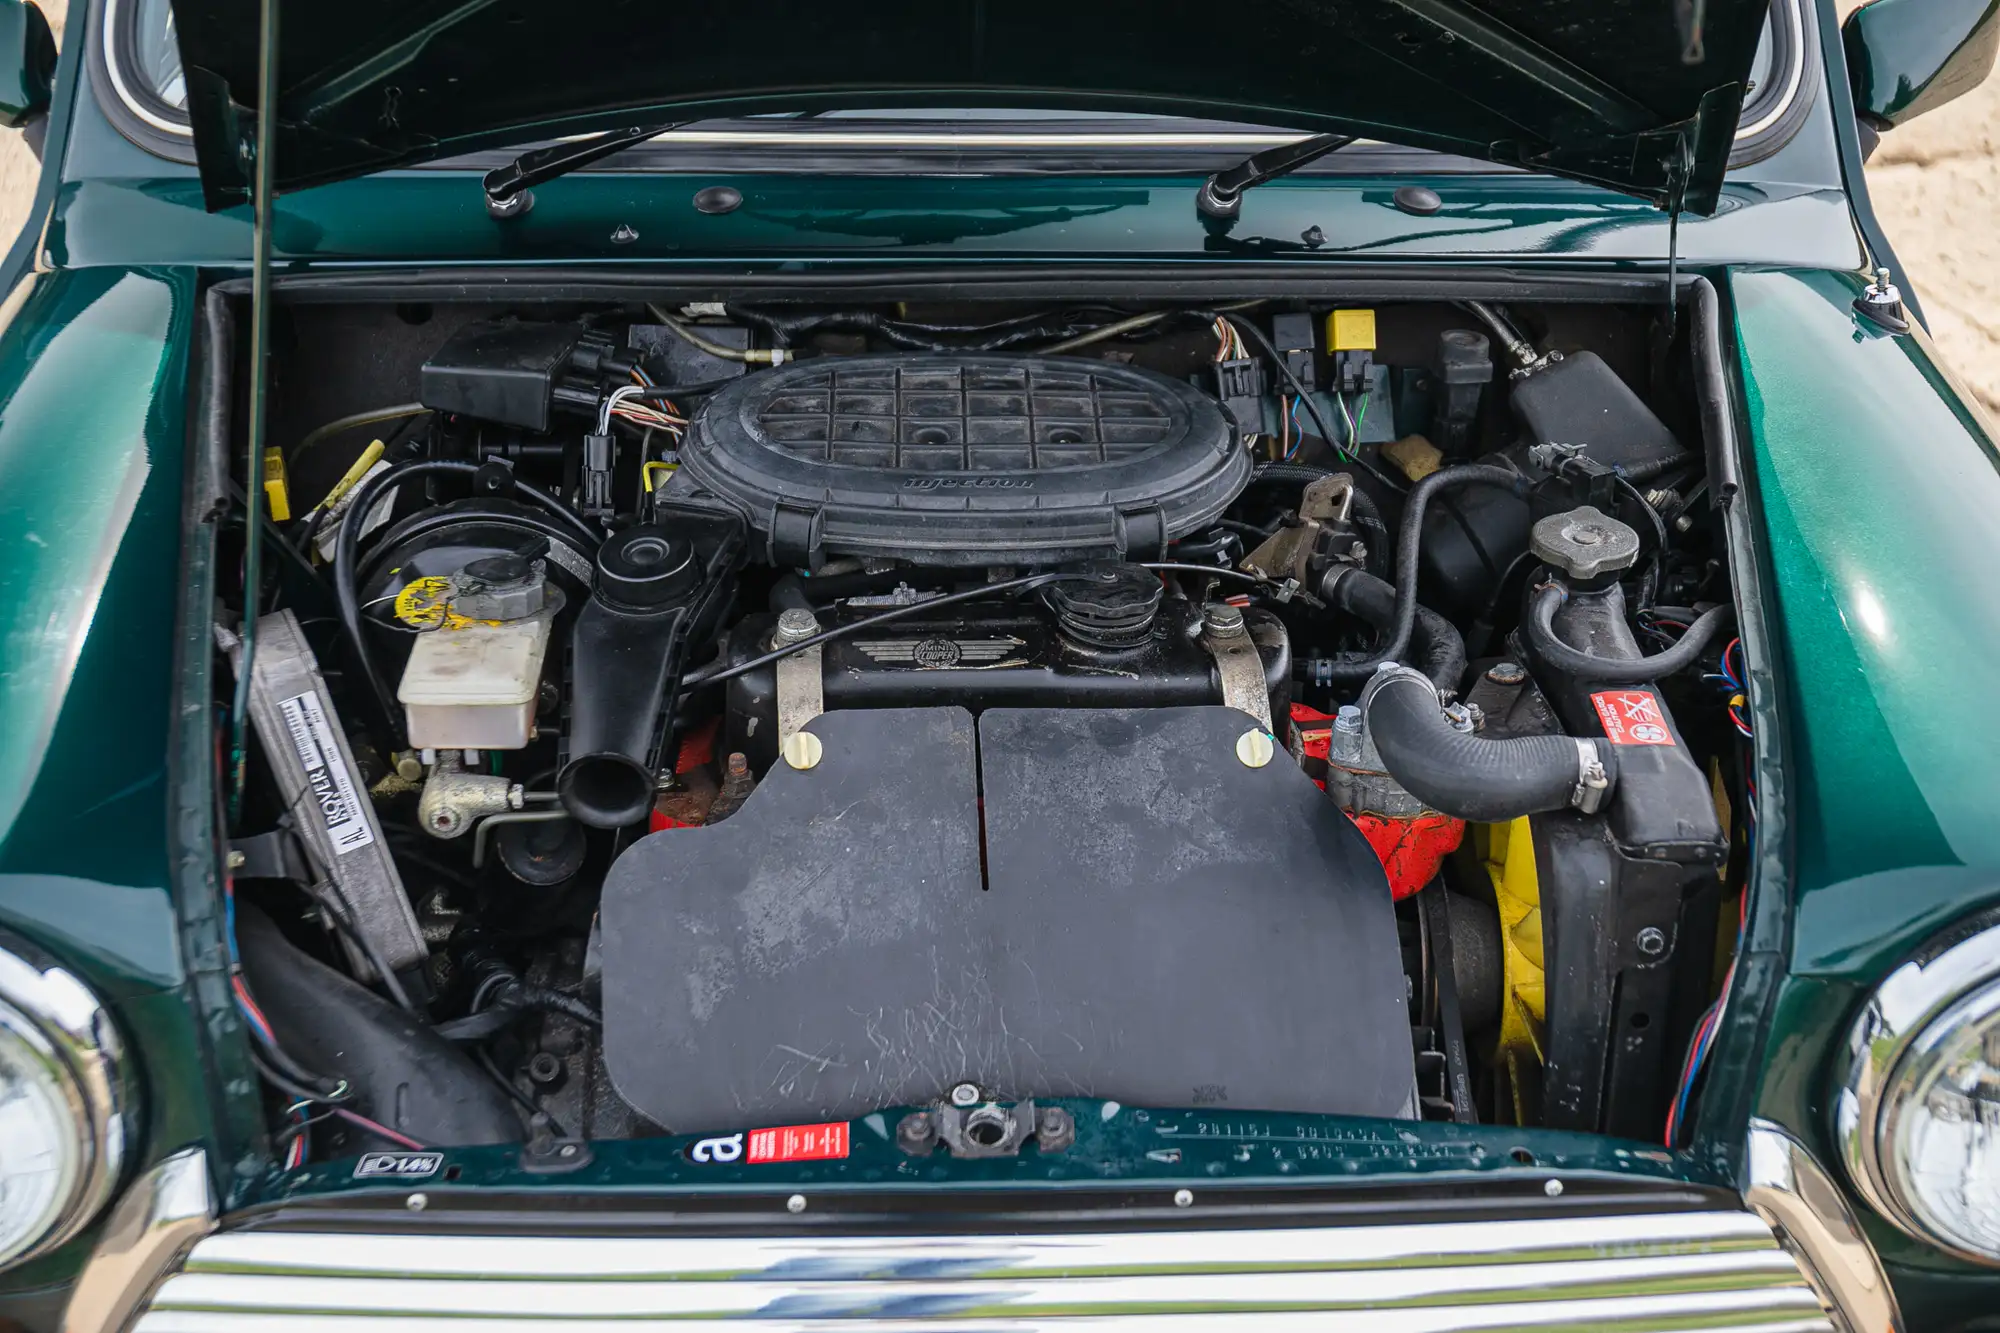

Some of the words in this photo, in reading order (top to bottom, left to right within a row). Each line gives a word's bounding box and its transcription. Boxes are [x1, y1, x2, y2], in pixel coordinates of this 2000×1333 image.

[903, 477, 1035, 492] injection
[921, 651, 954, 660] COOPER
[1606, 703, 1625, 733] CAUTION
[309, 768, 342, 827] ROVER
[338, 826, 368, 846] AL
